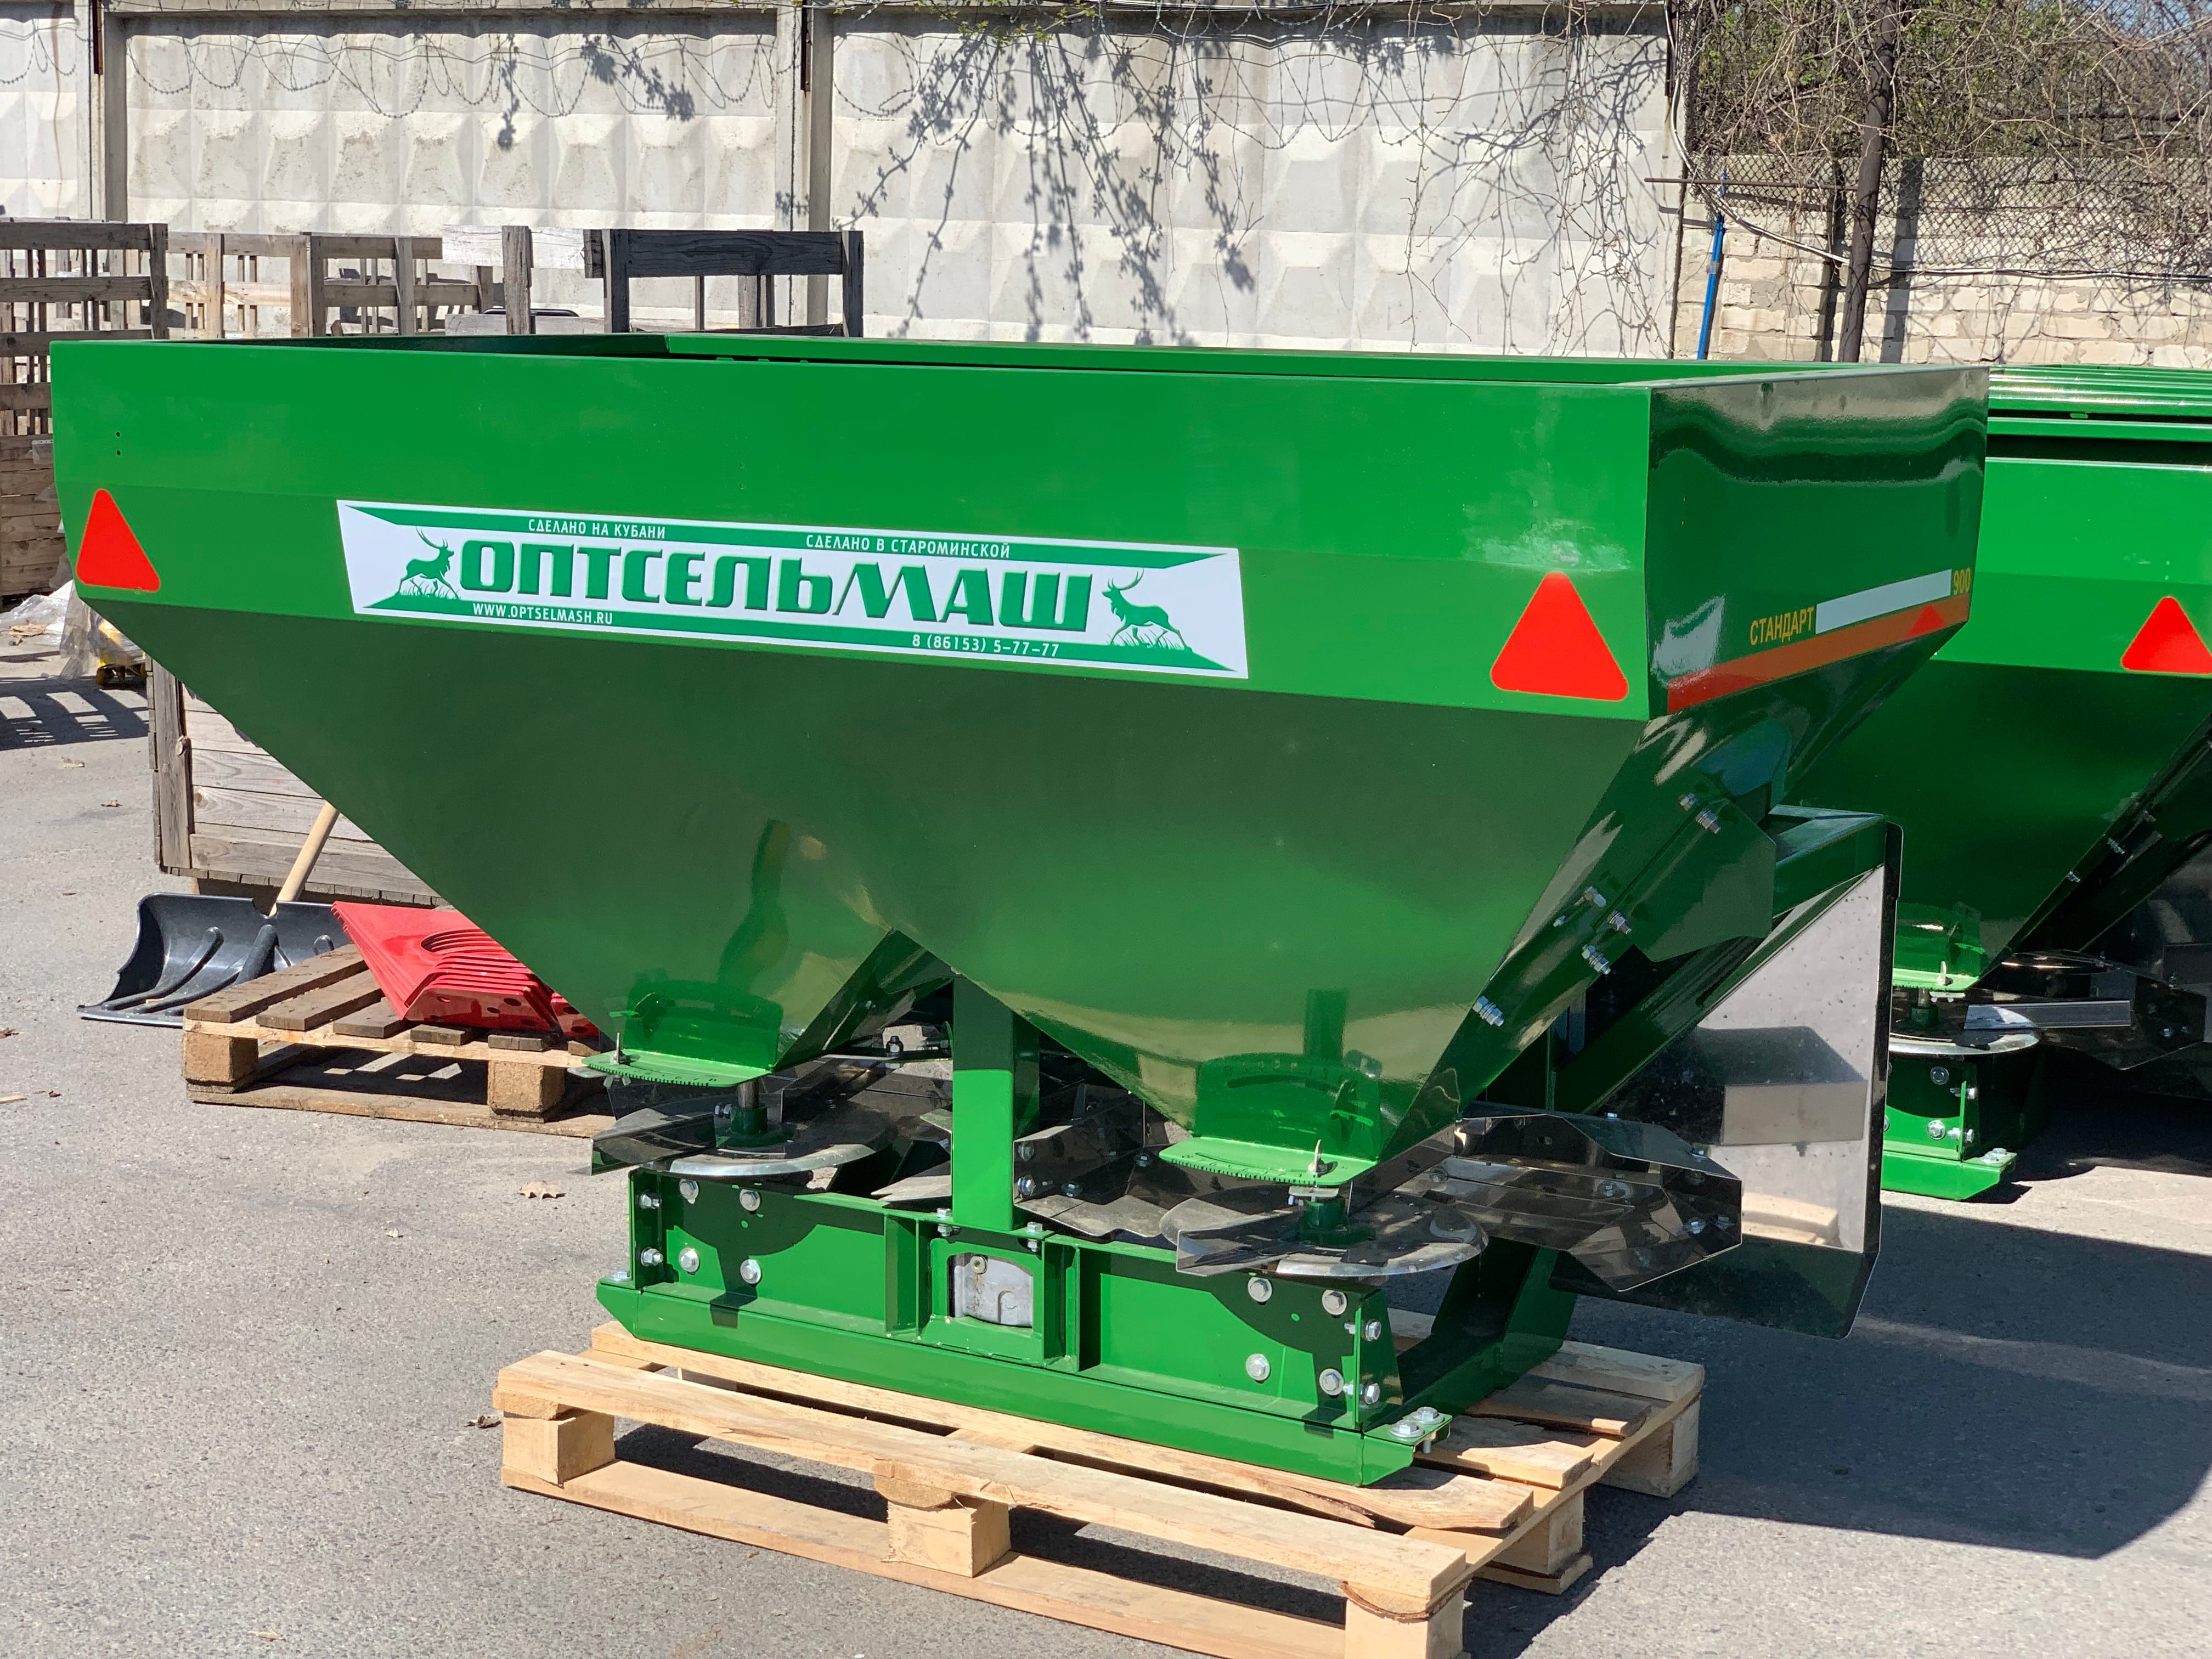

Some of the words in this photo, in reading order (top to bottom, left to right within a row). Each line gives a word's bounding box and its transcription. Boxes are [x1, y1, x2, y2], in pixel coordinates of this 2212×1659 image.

[528, 519, 586, 534] СДЕЛАНО
[591, 523, 610, 536] НА
[614, 524, 665, 539] КУБАНИ
[806, 534, 871, 550] СДЕЛАНО
[876, 538, 885, 551] В
[890, 539, 1010, 558] СТАРОМИНСКОЙ
[459, 539, 1092, 631] ОПТСЕЛЬМАШ
[1953, 568, 1971, 595] 900
[472, 602, 613, 625] WWW.OPTSELMASH.RU
[1750, 607, 1814, 646] СТАНДАРТ
[912, 634, 921, 647] 8
[927, 635, 986, 653] (86153)
